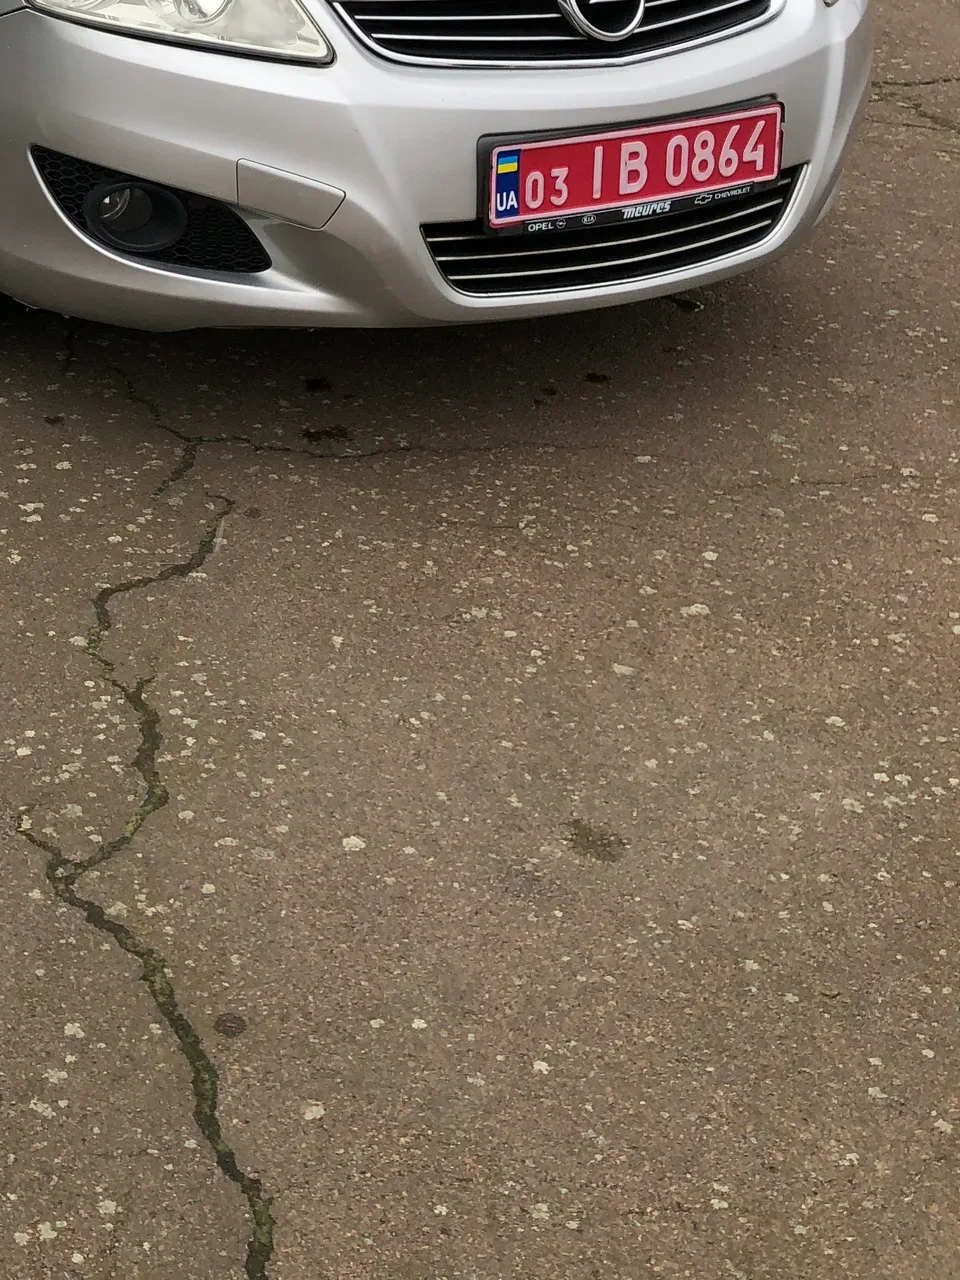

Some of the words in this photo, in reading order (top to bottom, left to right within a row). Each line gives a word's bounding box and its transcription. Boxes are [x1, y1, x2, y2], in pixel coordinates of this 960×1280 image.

[525, 167, 569, 209] 03
[592, 141, 648, 200] IB
[665, 120, 766, 187] 0864
[496, 190, 518, 211] UA
[527, 222, 554, 232] OPEL
[714, 186, 751, 200] CHEVROLET
